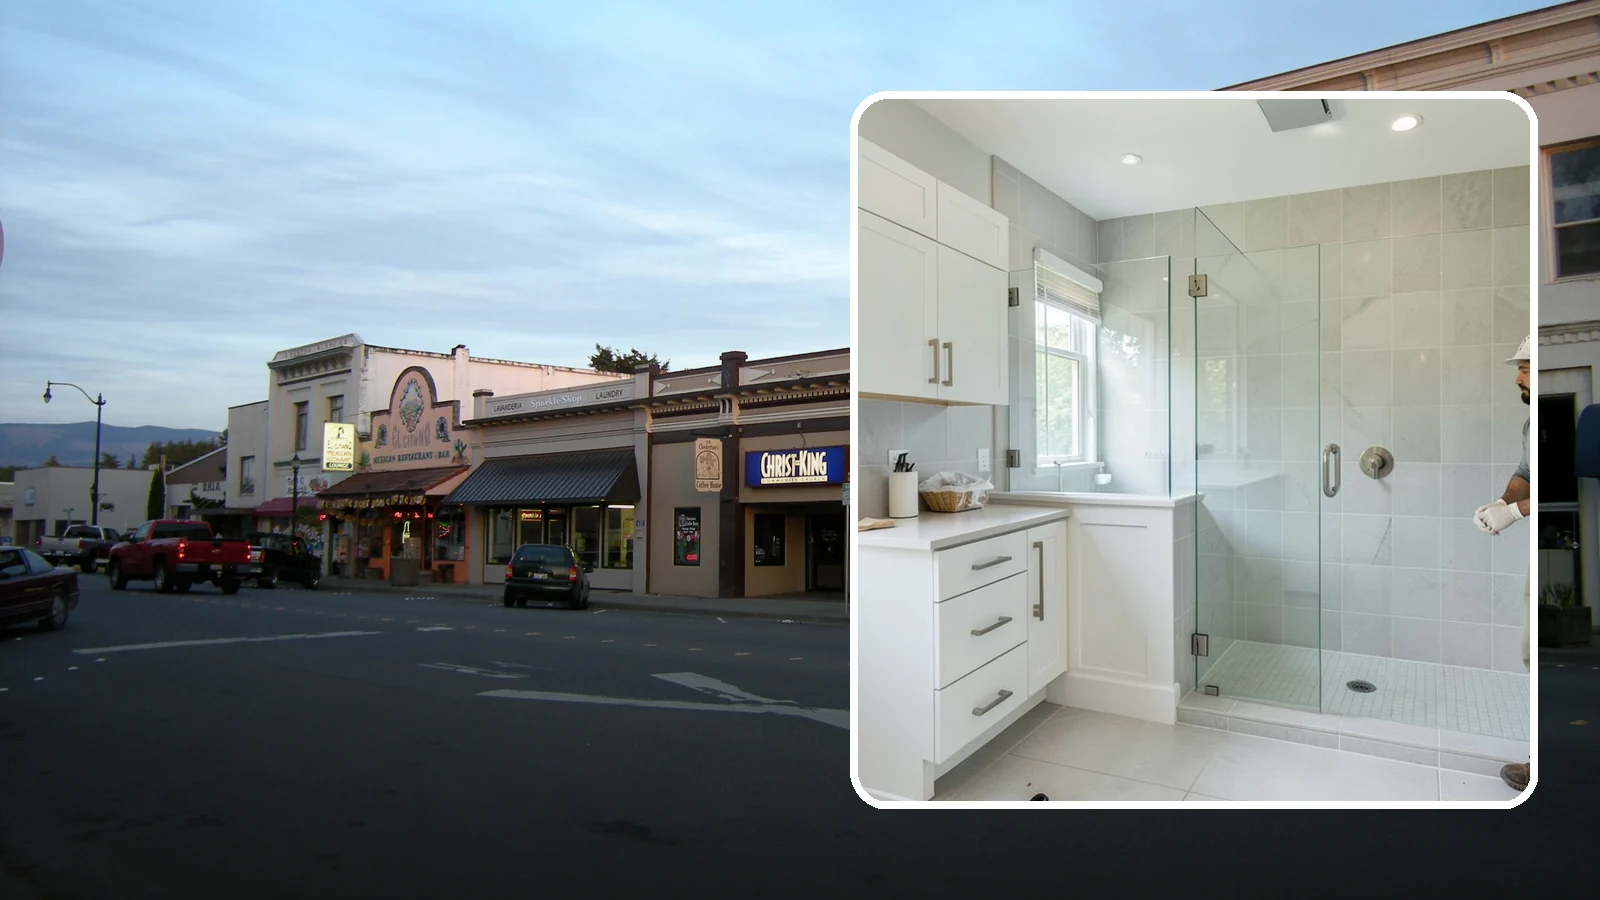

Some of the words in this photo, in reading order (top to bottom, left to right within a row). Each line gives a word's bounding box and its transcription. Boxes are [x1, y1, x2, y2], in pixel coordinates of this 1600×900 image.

[530, 397, 561, 409] Sparkle
[562, 394, 582, 404] Shop
[595, 389, 623, 400] LAUNDRY
[493, 402, 522, 413] LAVANDERIA
[374, 455, 396, 464] MEXICAN
[397, 451, 433, 462] RESTAURANT
[438, 450, 450, 459] BAR
[761, 452, 797, 477] CHRIST
[799, 450, 827, 476] KING
